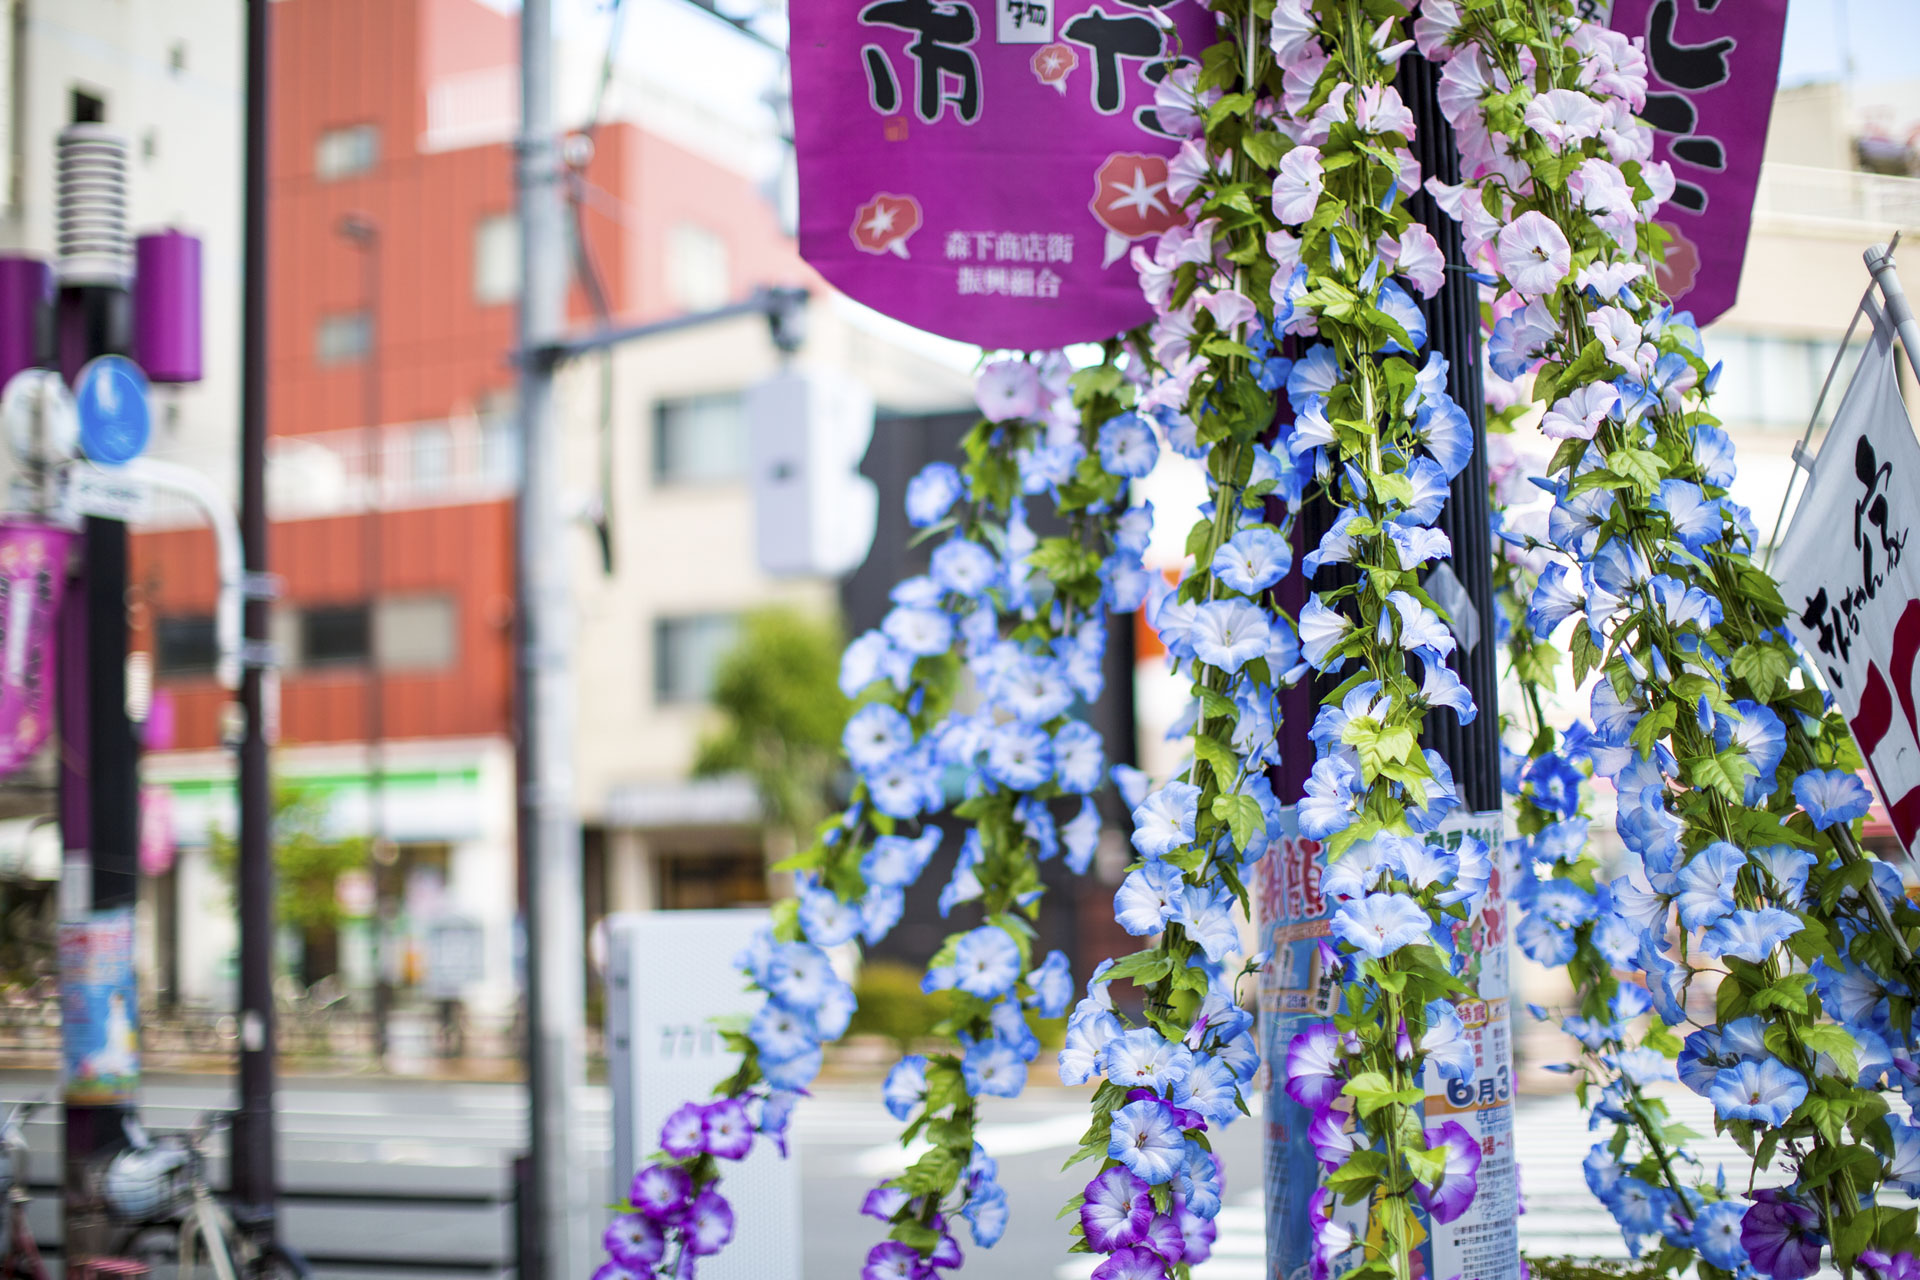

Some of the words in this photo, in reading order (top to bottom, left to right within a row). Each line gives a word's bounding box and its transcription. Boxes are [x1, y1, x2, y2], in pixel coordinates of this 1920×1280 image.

[943, 230, 1074, 263] 森下商店街
[957, 266, 1063, 298] 振興組合
